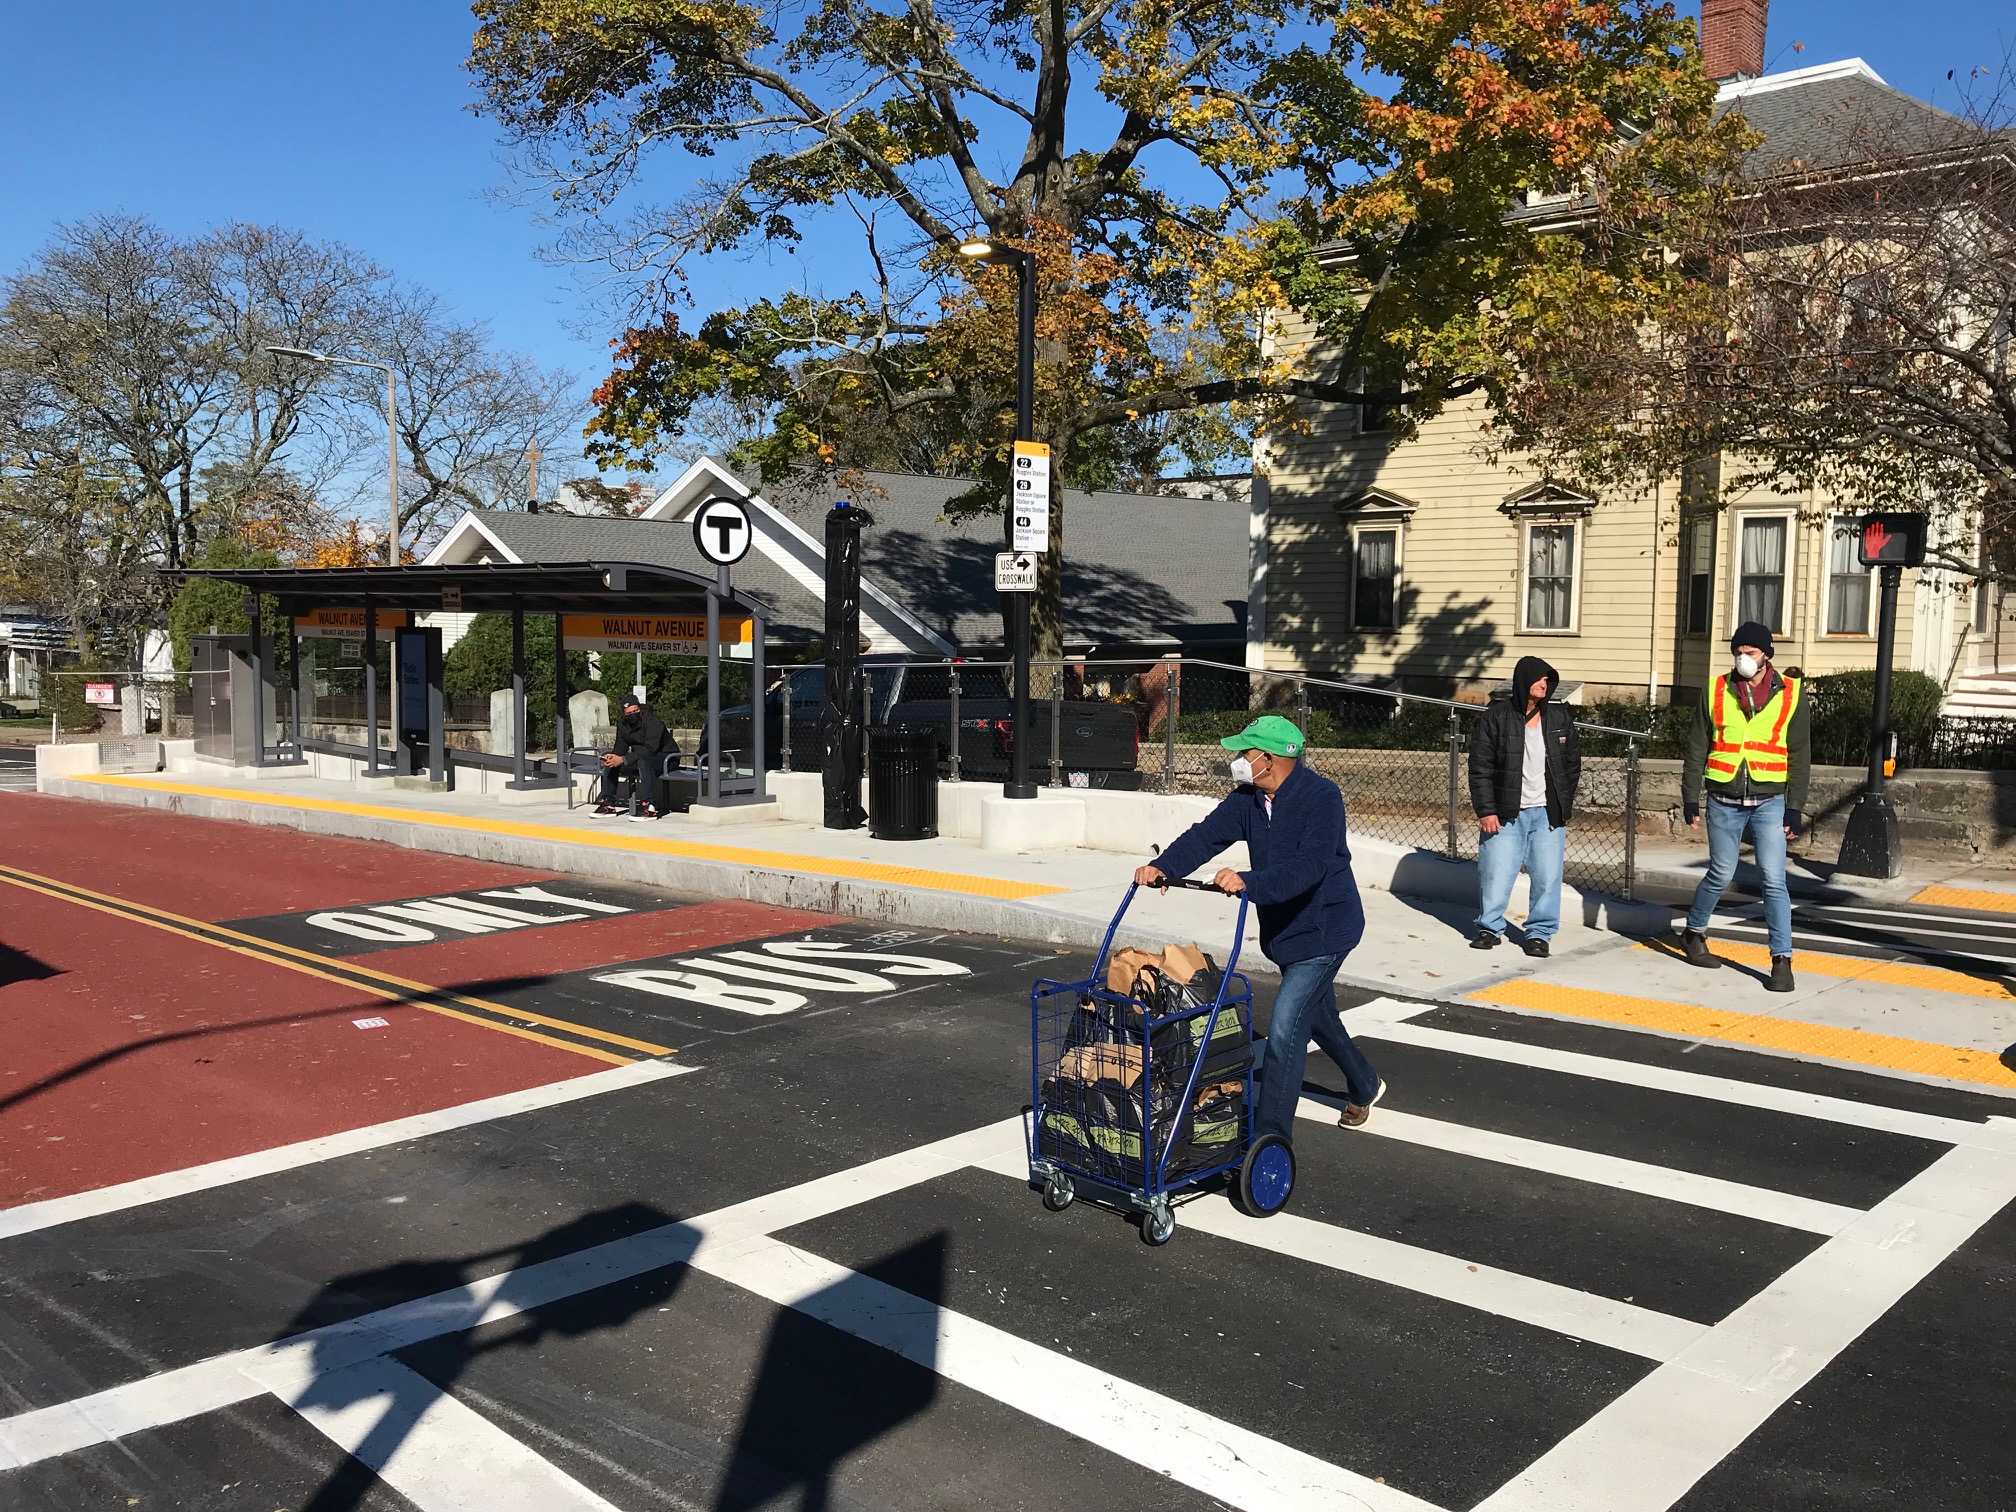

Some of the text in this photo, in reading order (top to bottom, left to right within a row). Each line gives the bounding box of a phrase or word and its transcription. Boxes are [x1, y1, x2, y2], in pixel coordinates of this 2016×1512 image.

[1020, 458, 1029, 468] 22
[1019, 480, 1028, 490] 29
[1019, 517, 1028, 527] 44
[706, 515, 743, 555] T
[1000, 559, 1015, 571] USE
[998, 573, 1034, 585] CROSSWALK
[318, 612, 380, 627] WALNUT AVEE
[602, 619, 705, 638] WALNUT AVENUE
[607, 640, 681, 652] WALNUT AVE, SEAVER ST
[305, 886, 634, 942] ONLY
[588, 941, 975, 1016] BUS
